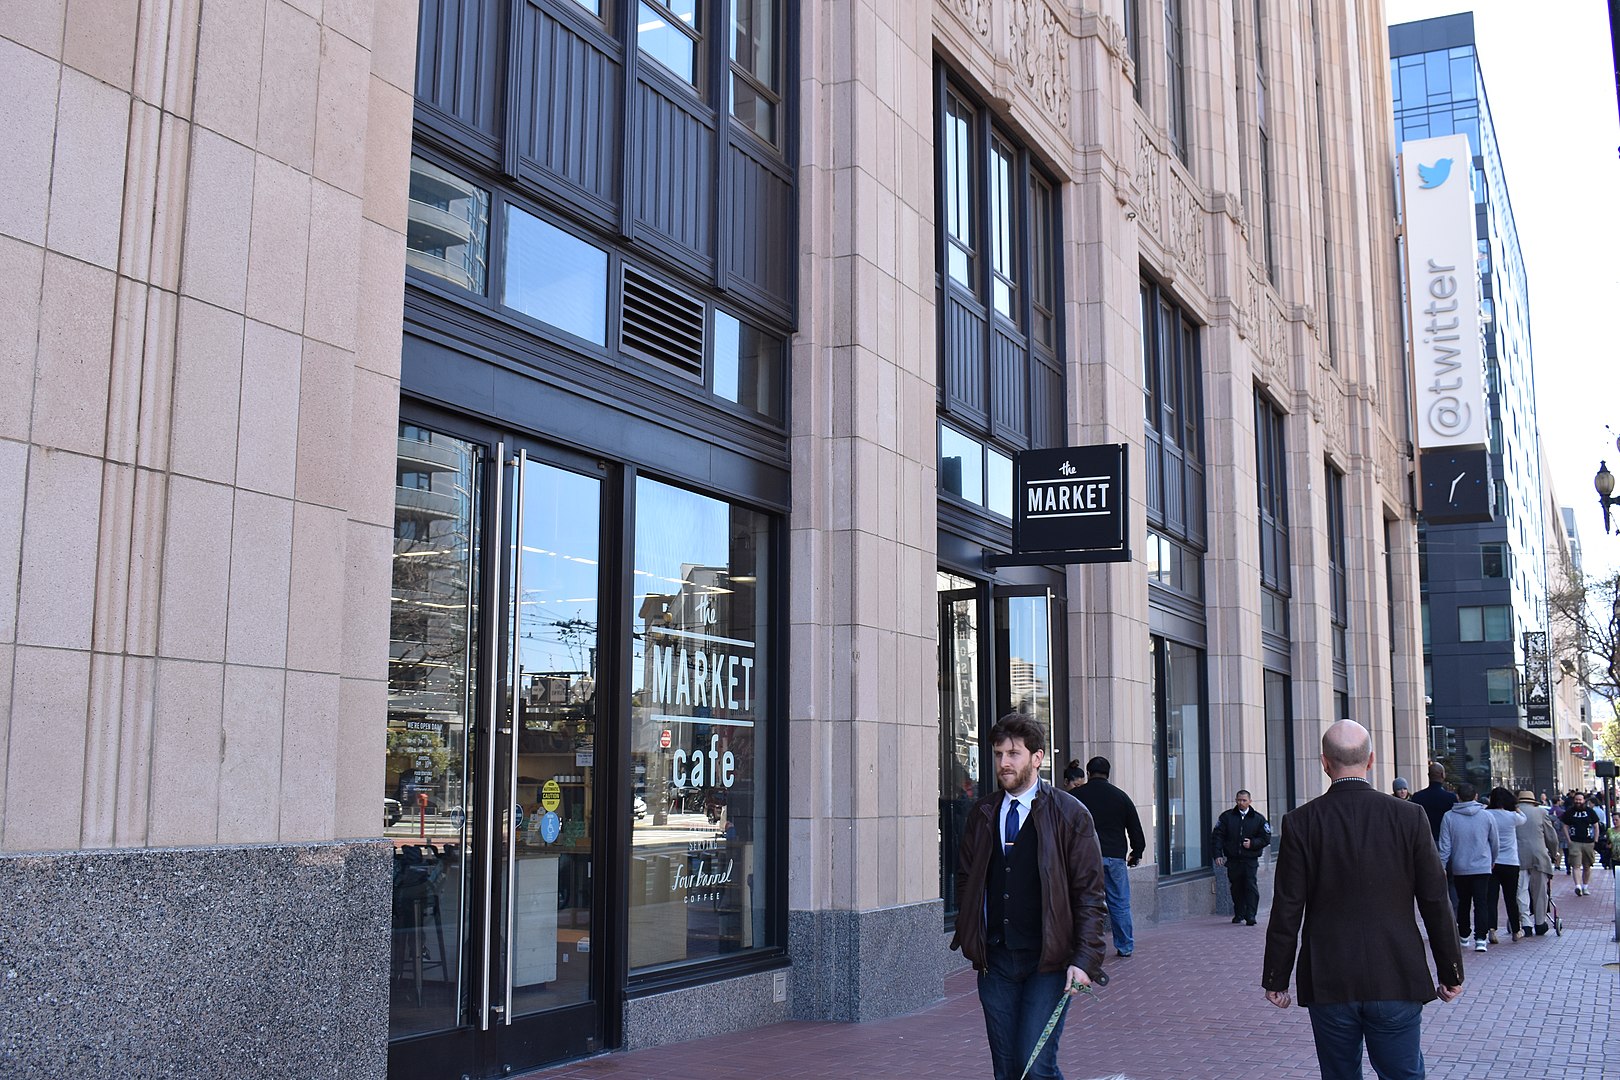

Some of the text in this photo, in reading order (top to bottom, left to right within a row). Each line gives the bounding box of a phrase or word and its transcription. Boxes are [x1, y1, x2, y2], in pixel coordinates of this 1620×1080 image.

[1424, 258, 1472, 438] @twitter
[1058, 460, 1077, 477] the
[1028, 483, 1110, 512] MARKET
[695, 592, 717, 626] the
[652, 644, 754, 711] MARKET
[672, 733, 736, 788] cafe
[688, 839, 718, 851] SERVING
[683, 892, 720, 904] COFFEE
